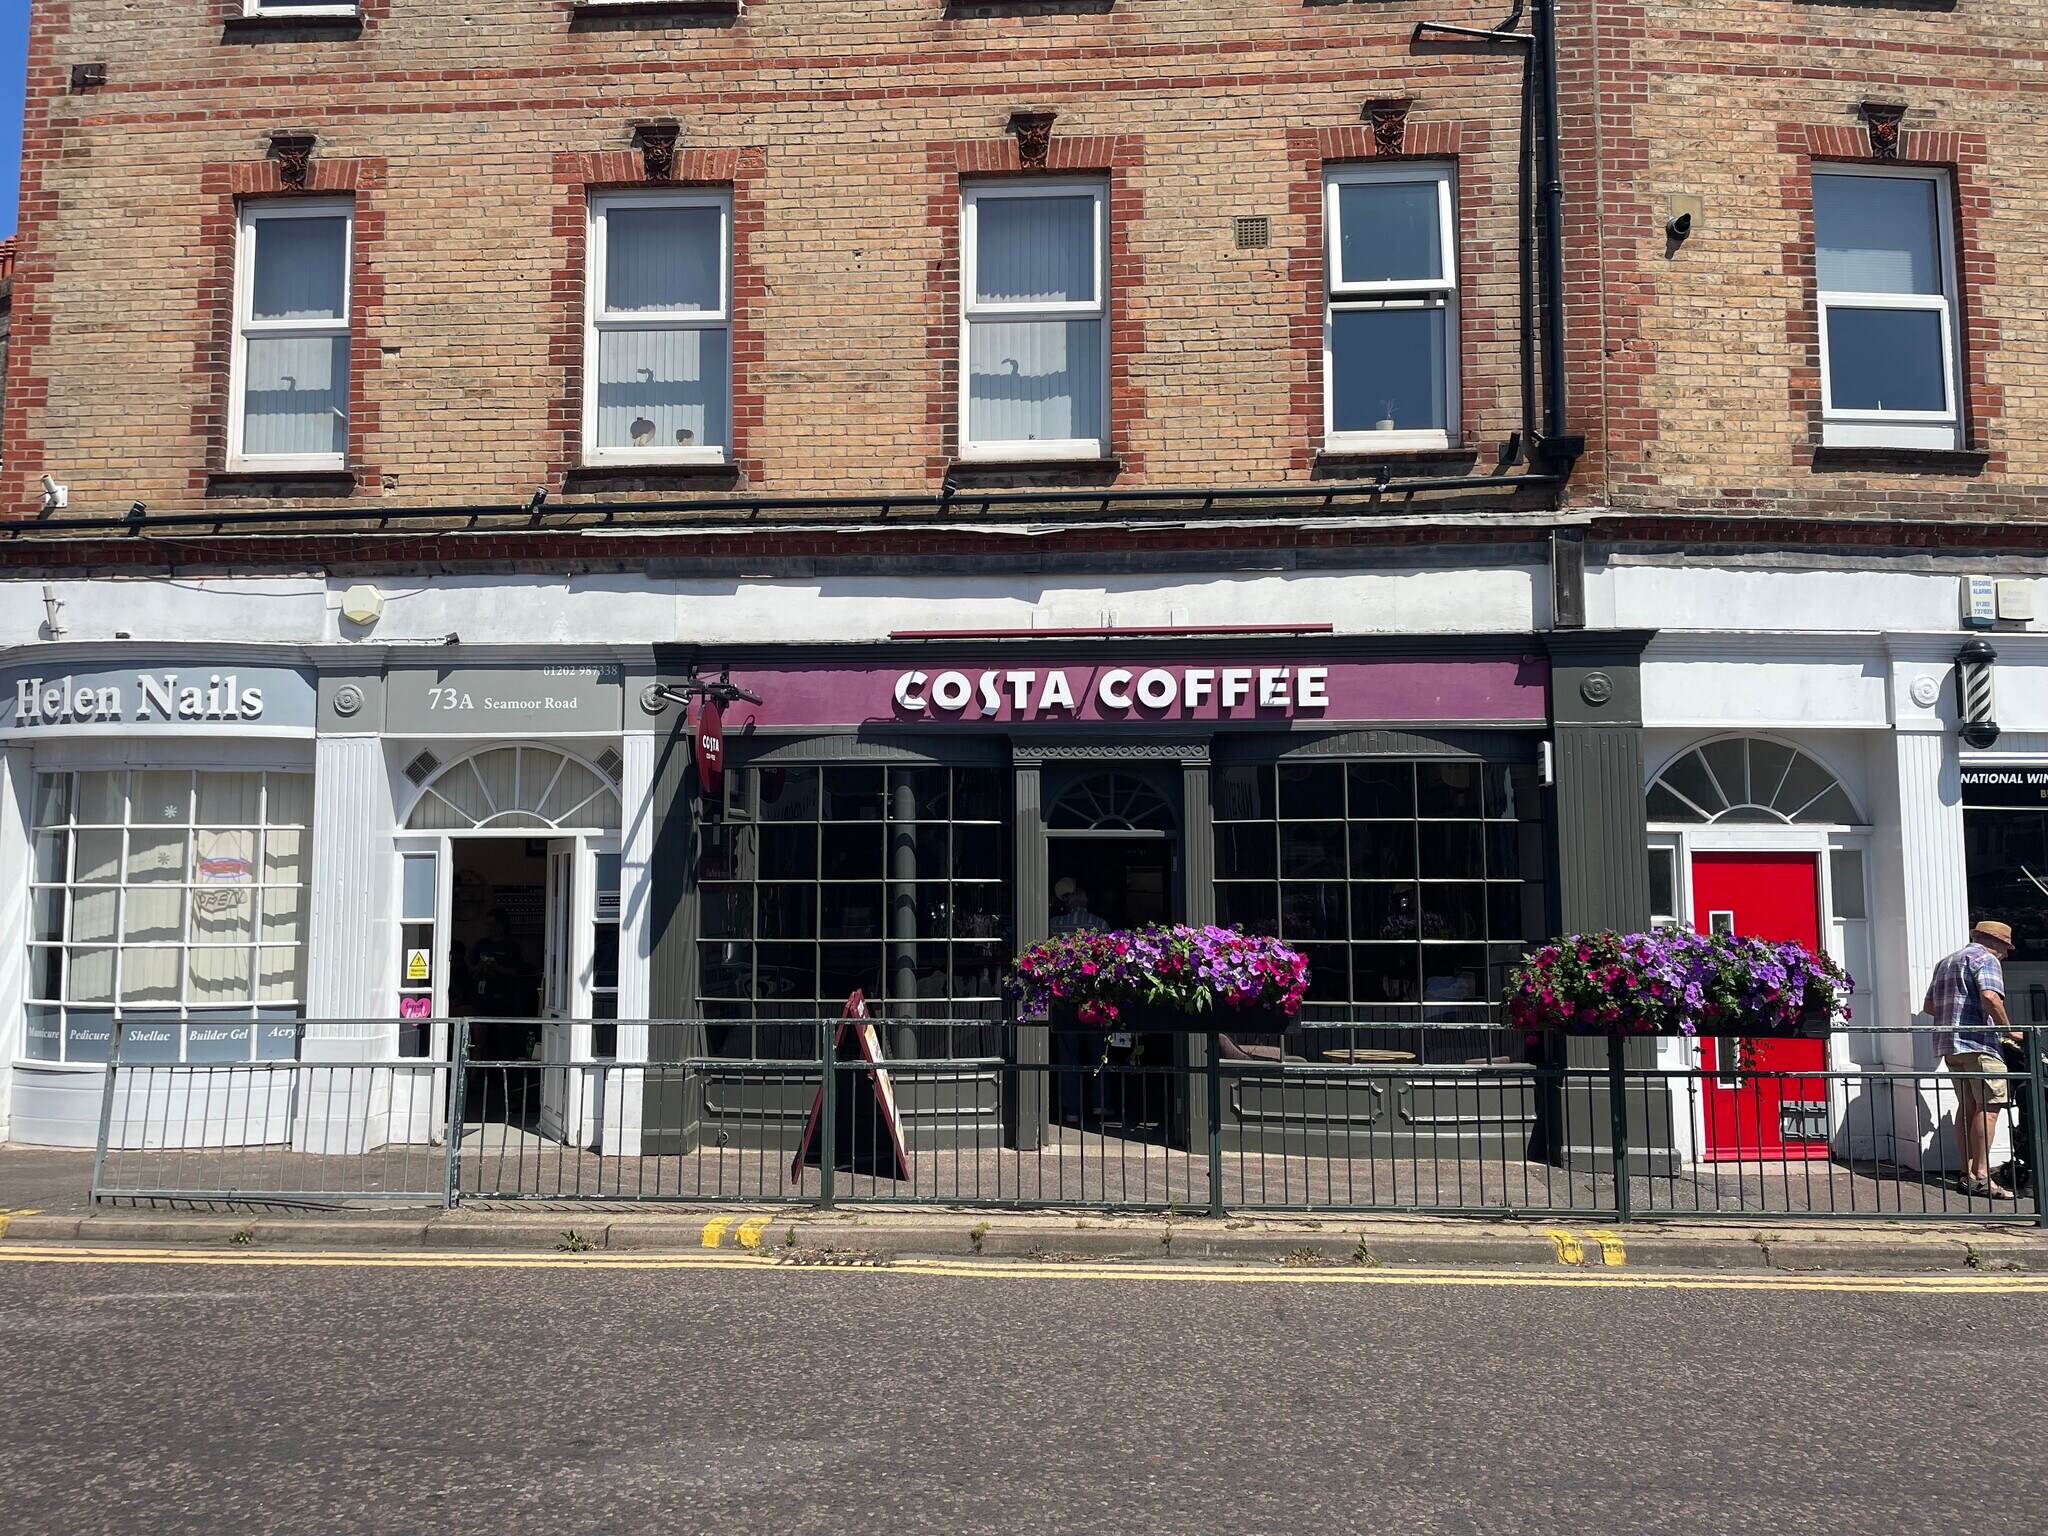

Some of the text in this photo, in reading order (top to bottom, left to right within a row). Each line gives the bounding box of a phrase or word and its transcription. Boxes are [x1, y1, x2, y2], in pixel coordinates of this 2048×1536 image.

[543, 666, 618, 676] 01202 987338
[15, 674, 264, 719] Helen Nails
[895, 668, 1330, 716] COSTA COFFEE
[428, 688, 578, 710] 73A Seamoor Road
[702, 735, 720, 752] COSTA
[1960, 773, 2024, 784] NATIONAL
[27, 1026, 60, 1039] Manicure
[69, 1029, 110, 1040] Pedicure
[128, 1030, 171, 1041] Shellac
[189, 1028, 249, 1041] Builder Gel
